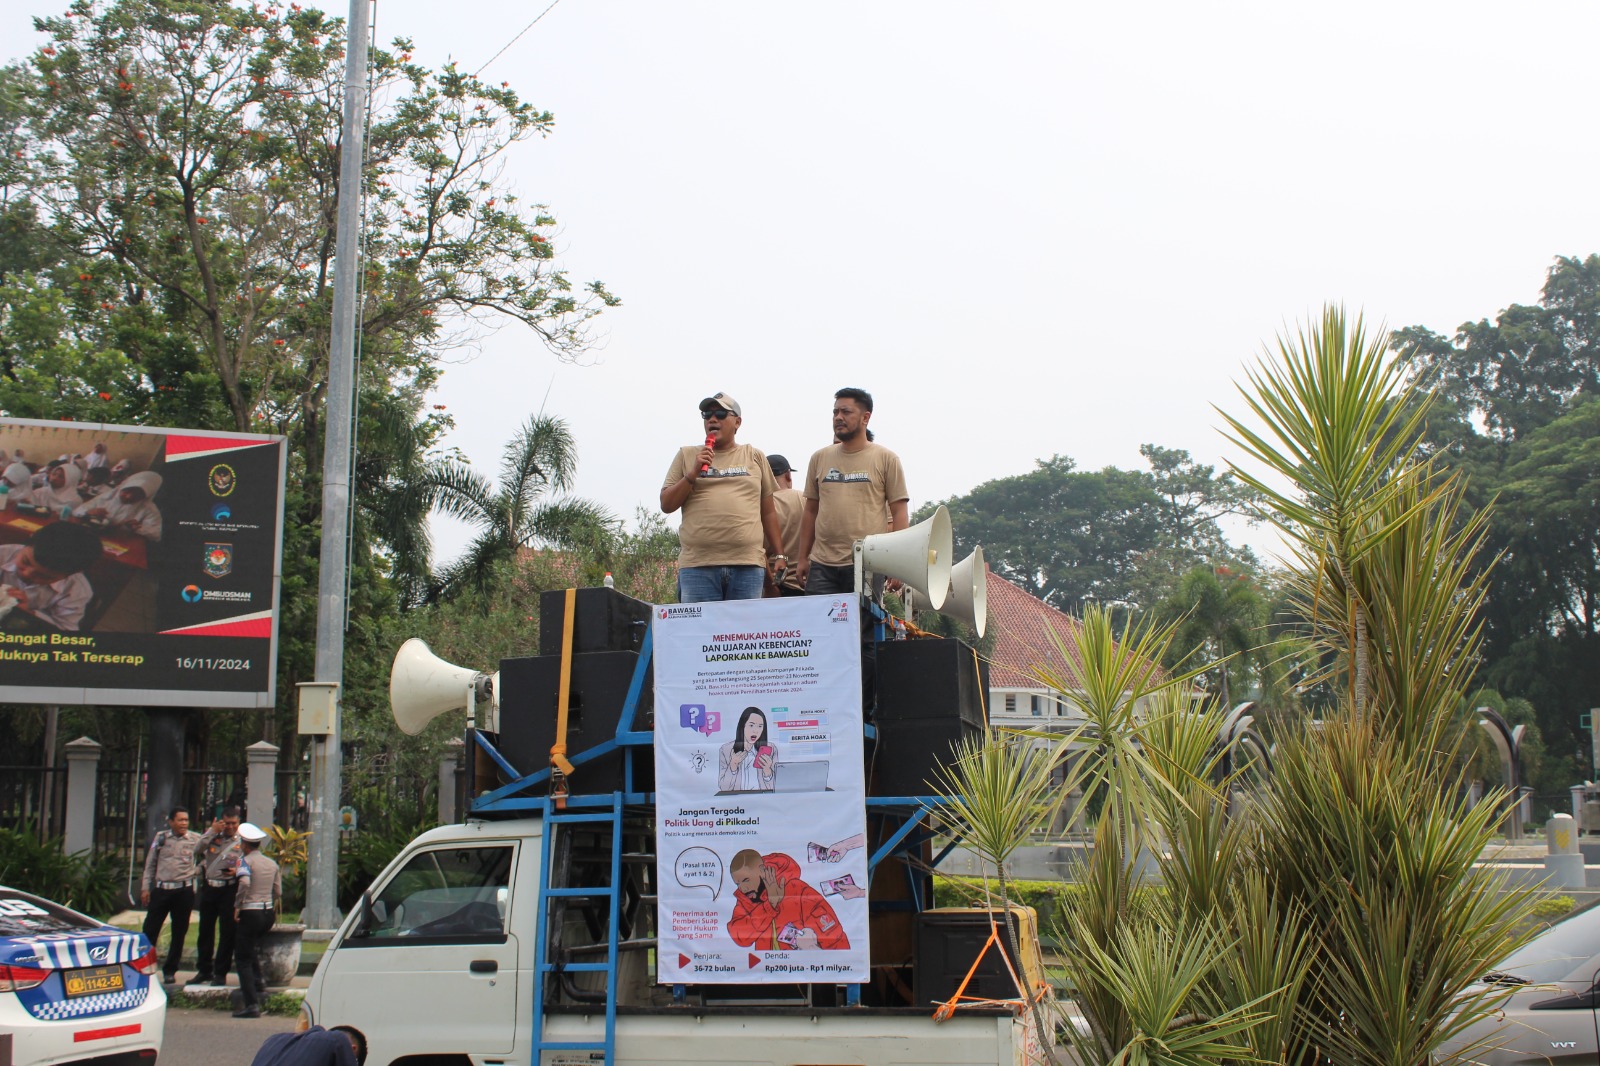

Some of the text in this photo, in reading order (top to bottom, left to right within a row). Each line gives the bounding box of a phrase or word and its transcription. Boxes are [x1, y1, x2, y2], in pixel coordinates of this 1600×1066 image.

[203, 590, 252, 599] OMBUDSMAN
[668, 606, 702, 615] BAWASLU
[0, 631, 96, 647] Sangat Besar,
[712, 629, 801, 643] MENEMUKAN HOAKS
[702, 639, 813, 653] DAN UJARAN KEBENCIAN?
[52, 651, 78, 662] Tak
[82, 651, 144, 667] Terserap
[705, 649, 809, 663] LAPORKAN KE BAWASLU
[175, 657, 251, 671] 16/11/2024
[678, 806, 745, 817] Jangan Tergoda
[664, 817, 760, 828] Politik Uang di Pilkada!
[693, 953, 722, 961] Penjara:
[765, 965, 788, 973] Rp200
[788, 965, 805, 973] juta
[810, 965, 824, 973] Rp1
[825, 964, 853, 973] milyar.
[87, 975, 121, 990] 1142-50
